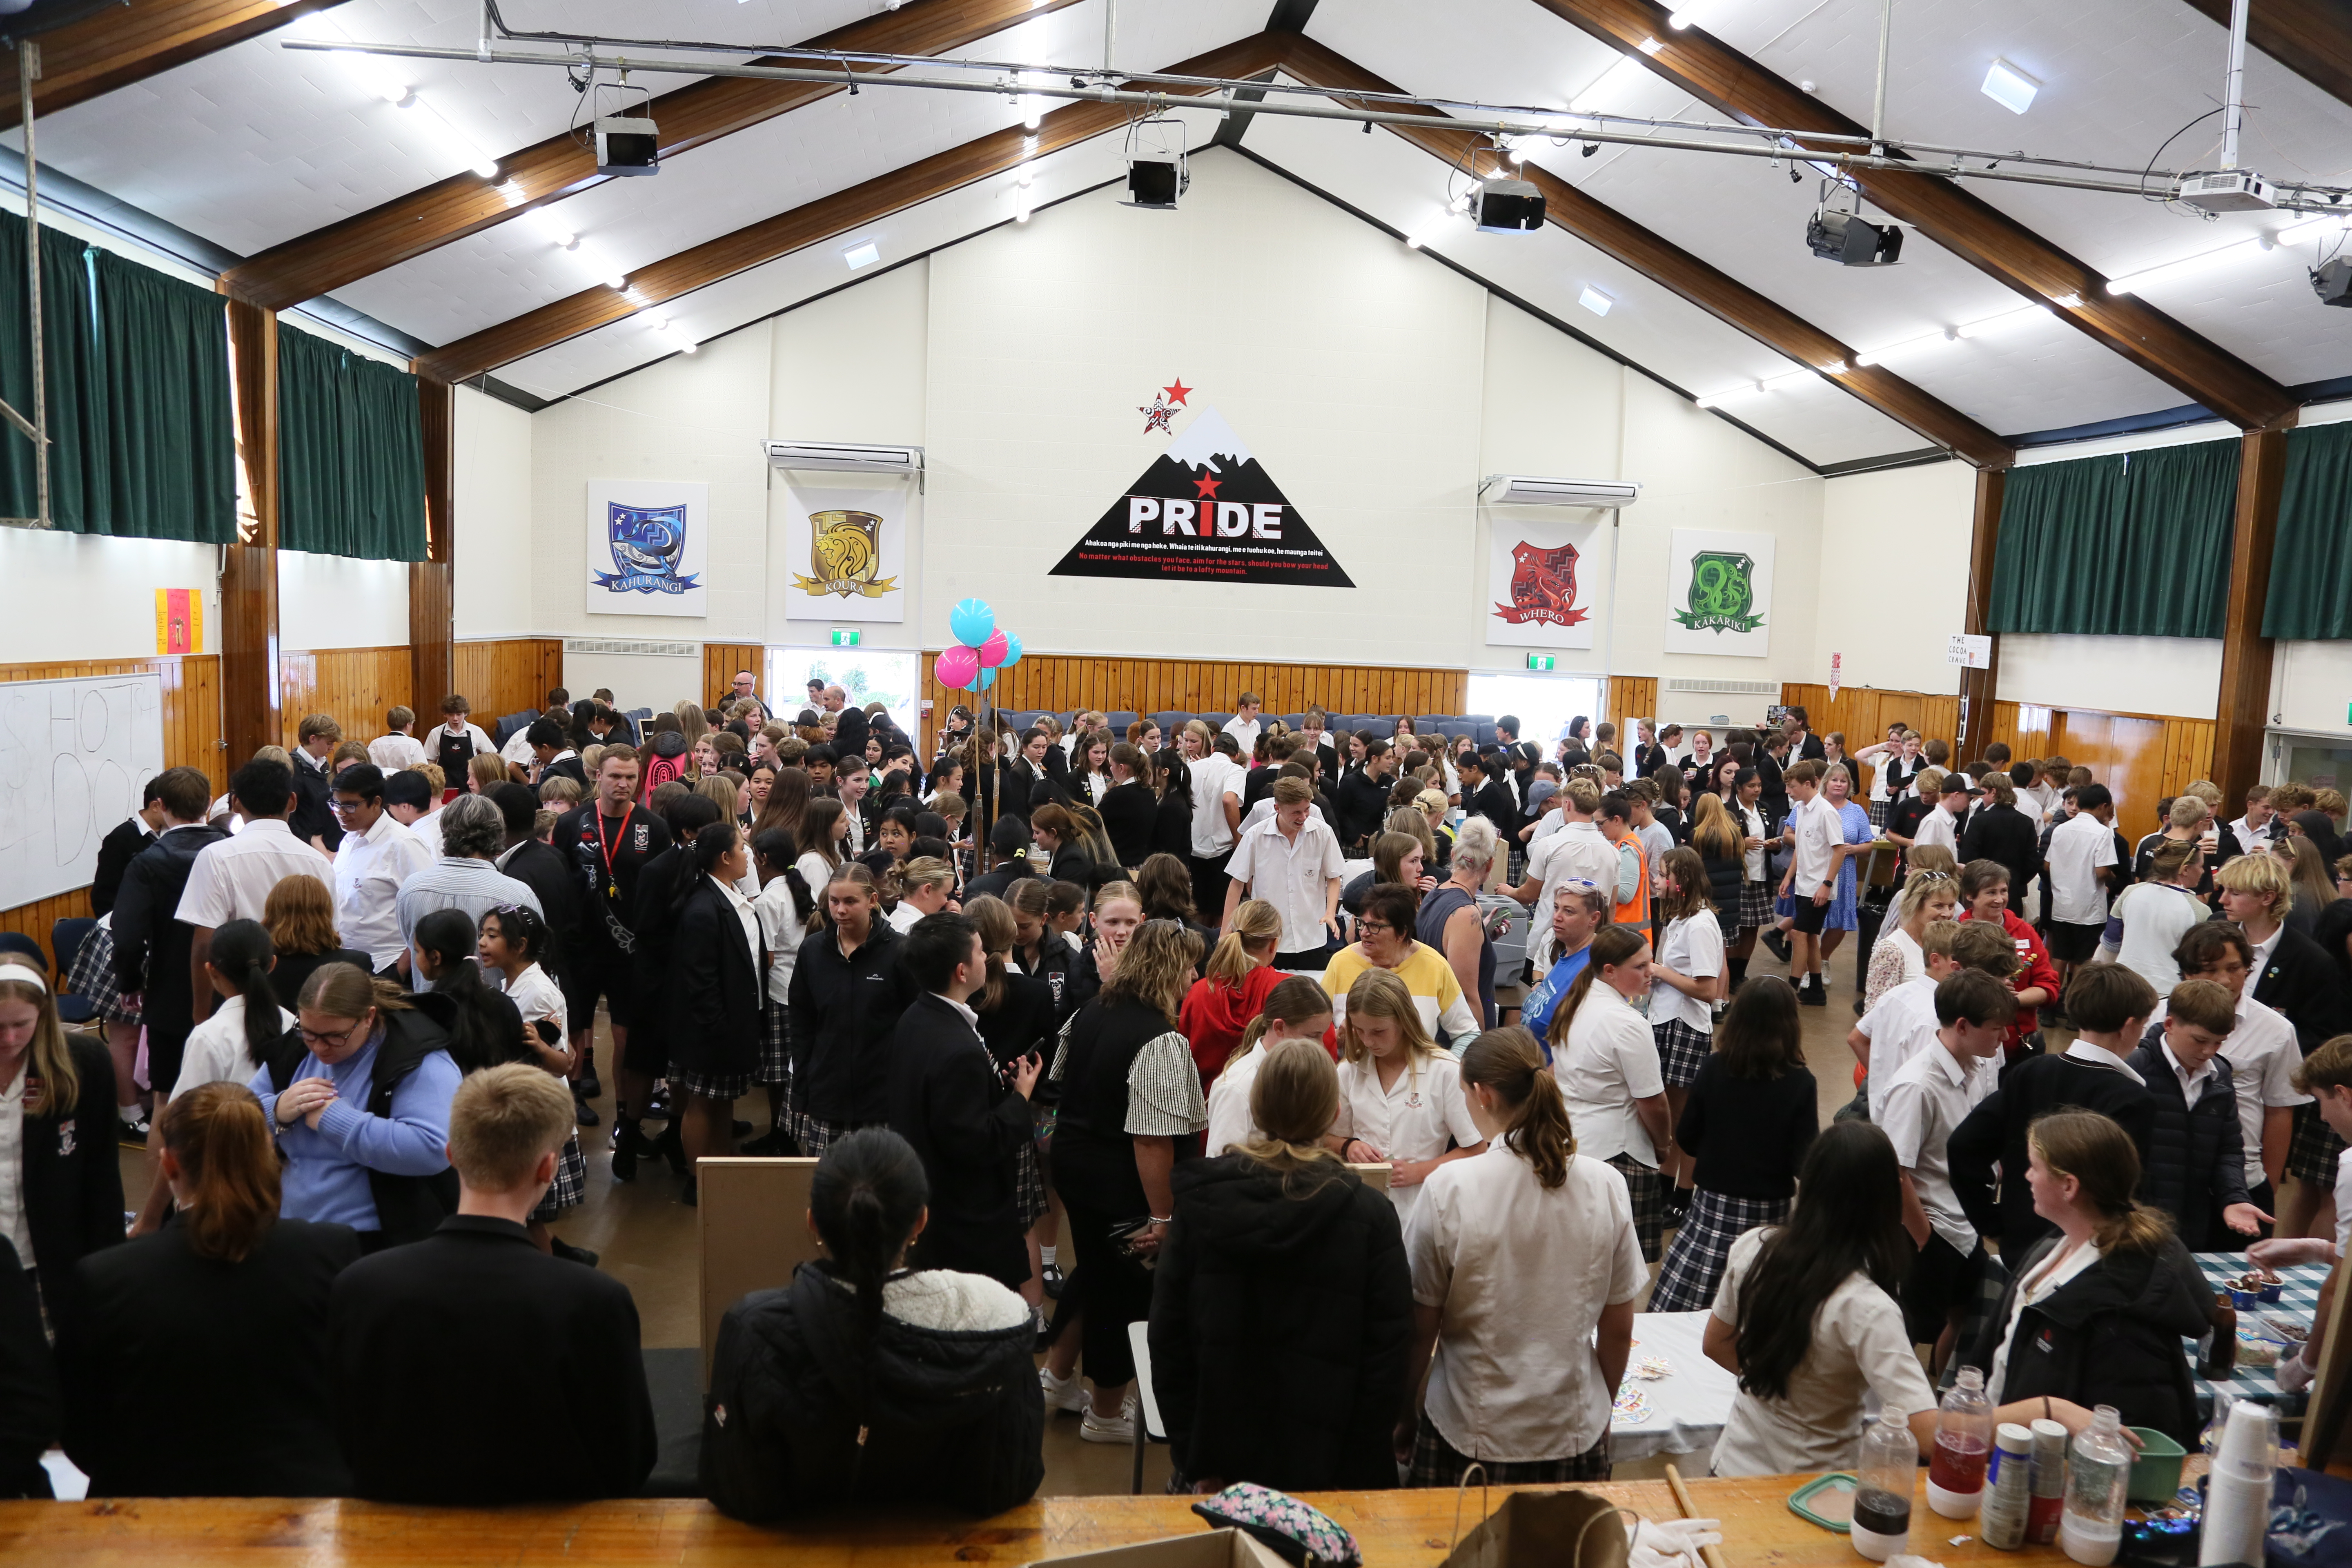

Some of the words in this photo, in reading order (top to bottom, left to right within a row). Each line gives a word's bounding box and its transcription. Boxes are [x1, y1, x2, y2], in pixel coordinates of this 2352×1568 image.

[611, 576, 682, 592] KAHURANGI
[1519, 609, 1564, 623] WHERO
[1694, 615, 1745, 631] KĀKĀRIKI
[1949, 646, 1967, 655] COCOA
[1949, 656, 1966, 664] CRAVE
[50, 683, 143, 762] HOT
